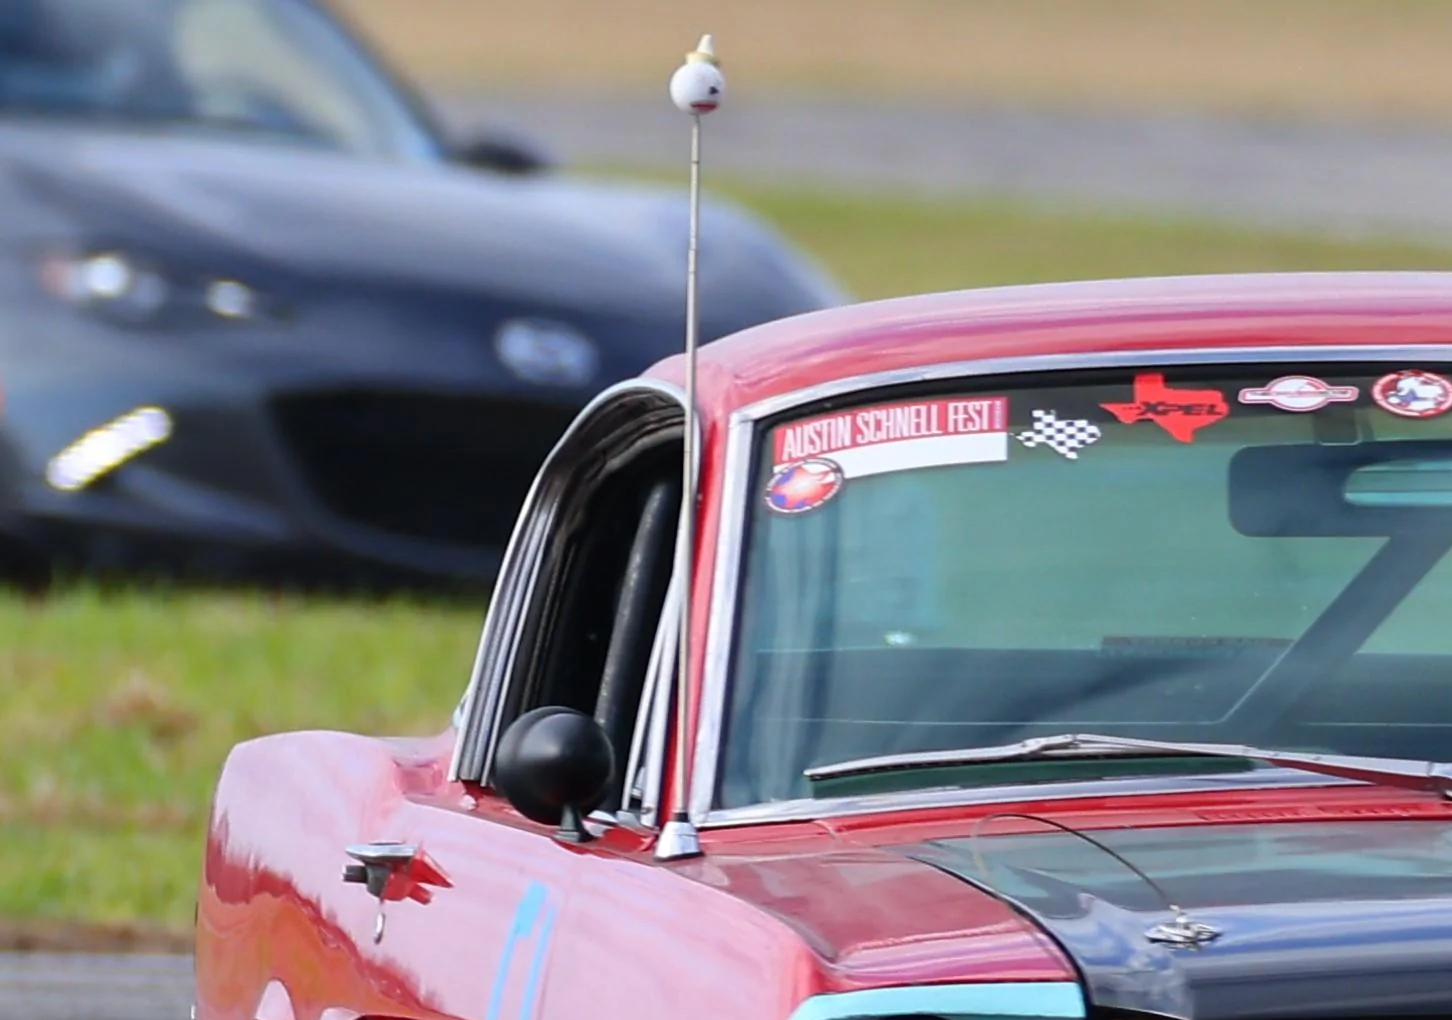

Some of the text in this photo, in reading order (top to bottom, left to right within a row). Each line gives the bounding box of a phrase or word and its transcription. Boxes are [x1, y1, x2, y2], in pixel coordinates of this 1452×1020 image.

[781, 415, 852, 461] AUSTIN
[856, 404, 942, 444] SCHNELL
[947, 400, 992, 433] FEST
